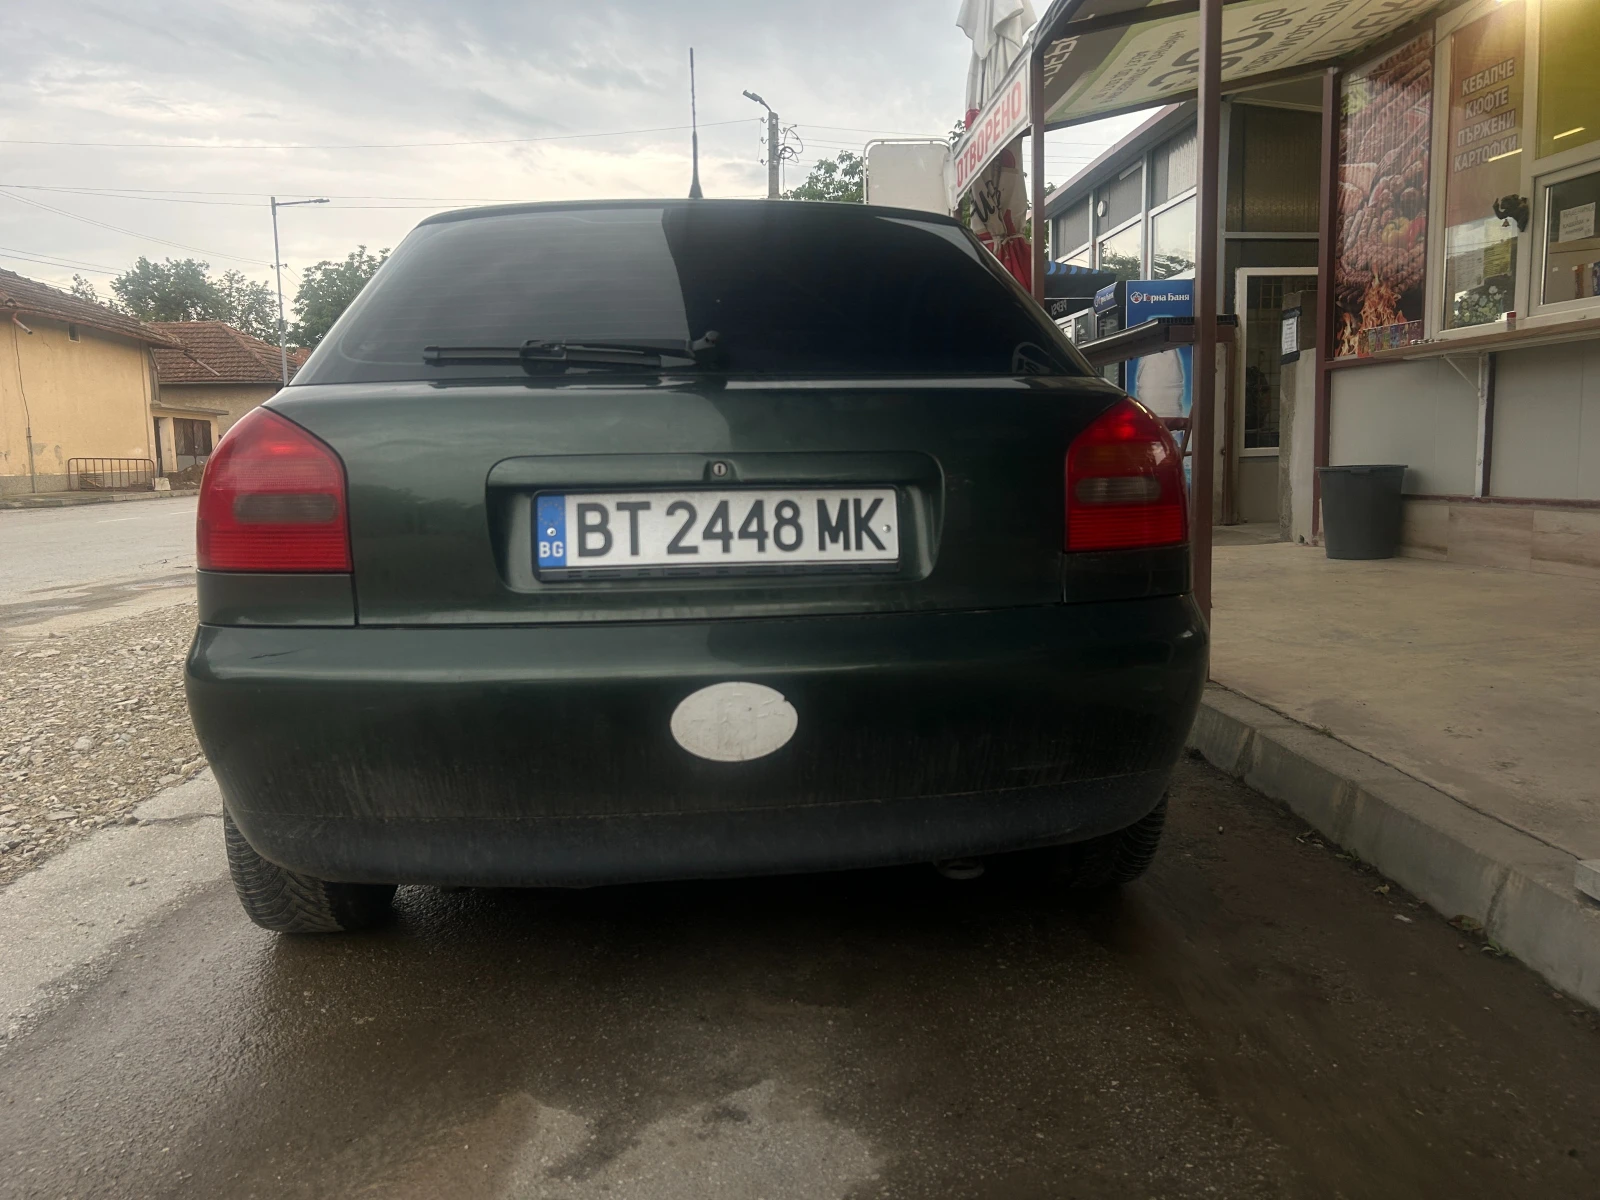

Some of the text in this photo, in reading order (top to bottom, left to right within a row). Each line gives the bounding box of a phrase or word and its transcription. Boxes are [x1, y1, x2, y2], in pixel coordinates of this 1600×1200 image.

[1462, 58, 1515, 96] КЕБАПЧЕ
[1465, 86, 1508, 119] КЮФТЕ
[956, 81, 1022, 188] ОТВОРЕНО
[1457, 109, 1516, 147] ПЪРЖЕНИ
[1453, 134, 1517, 173] КАРТОФКИ
[1143, 292, 1190, 304] Горна Баня
[577, 497, 887, 557] BT 2448 MK
[539, 541, 564, 559] BG
